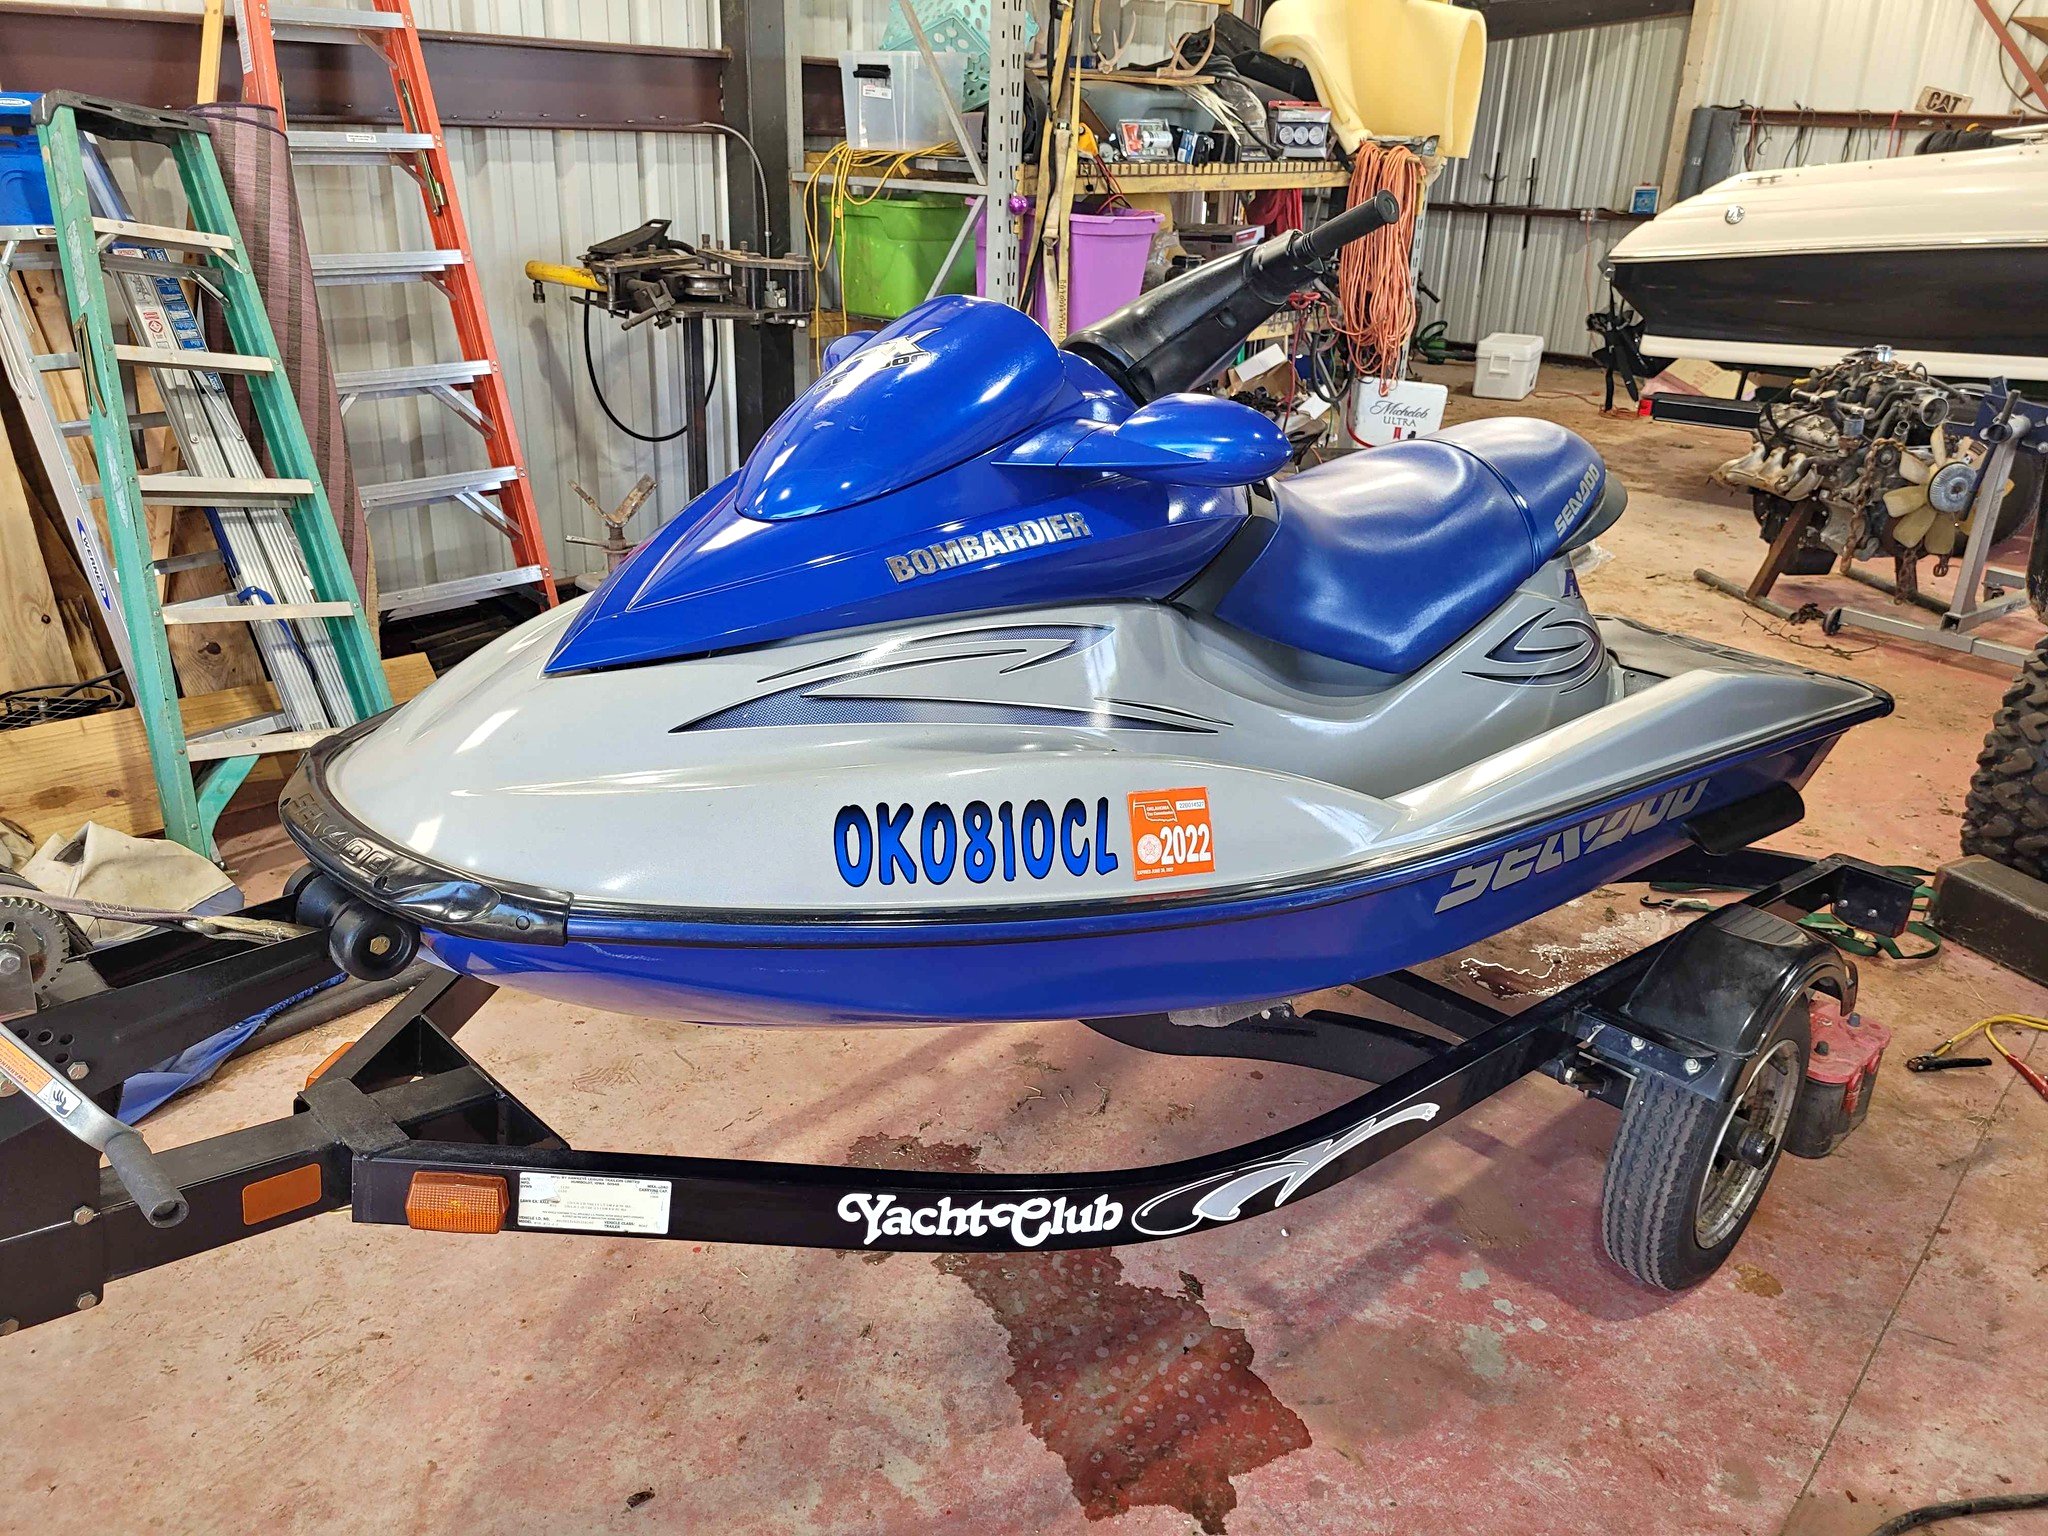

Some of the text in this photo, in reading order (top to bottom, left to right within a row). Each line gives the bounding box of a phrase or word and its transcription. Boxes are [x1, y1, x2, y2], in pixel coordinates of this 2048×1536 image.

[1926, 91, 1963, 114] CAT
[1370, 400, 1430, 419] Michelob
[1383, 416, 1417, 427] ULTRA
[83, 537, 105, 591] WERNER
[885, 512, 1093, 585] BOMBARDIER
[834, 797, 1119, 887] OK0810CL
[1160, 823, 1212, 865] 2022
